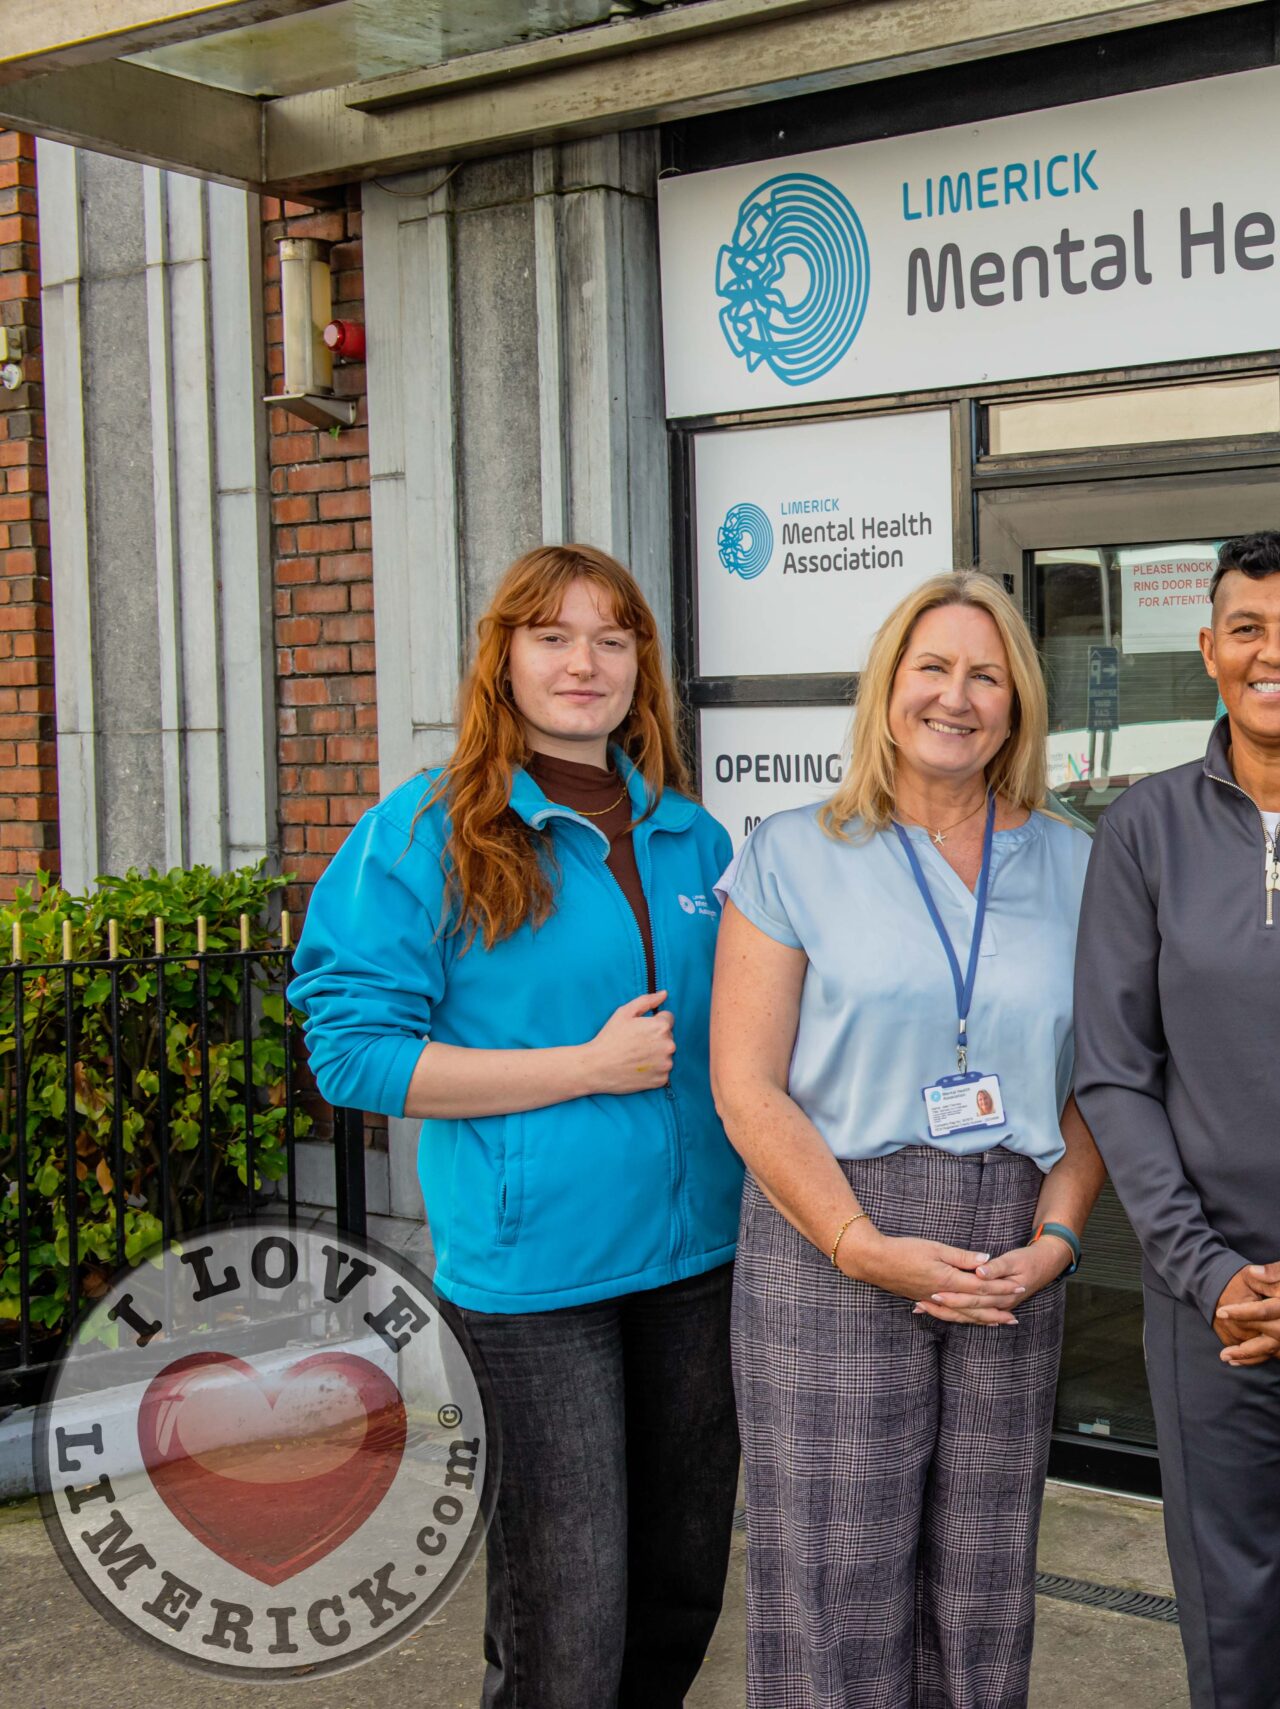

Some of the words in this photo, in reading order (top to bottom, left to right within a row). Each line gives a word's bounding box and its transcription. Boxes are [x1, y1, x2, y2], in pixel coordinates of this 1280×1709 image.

[902, 149, 1099, 221] LIMERICK
[907, 209, 1153, 316] Mental
[781, 498, 840, 515] LIMERICK
[782, 517, 855, 545] Mental
[862, 511, 932, 540] Health
[783, 545, 903, 574] Association
[1133, 563, 1173, 575] PLEASE
[1176, 561, 1213, 573] KNOCK
[1133, 581, 1159, 592] RING
[1162, 579, 1192, 590] DOOR
[1138, 596, 1160, 607] FOR
[1162, 594, 1212, 606] ATTENTIO
[715, 753, 843, 783] OPENING
